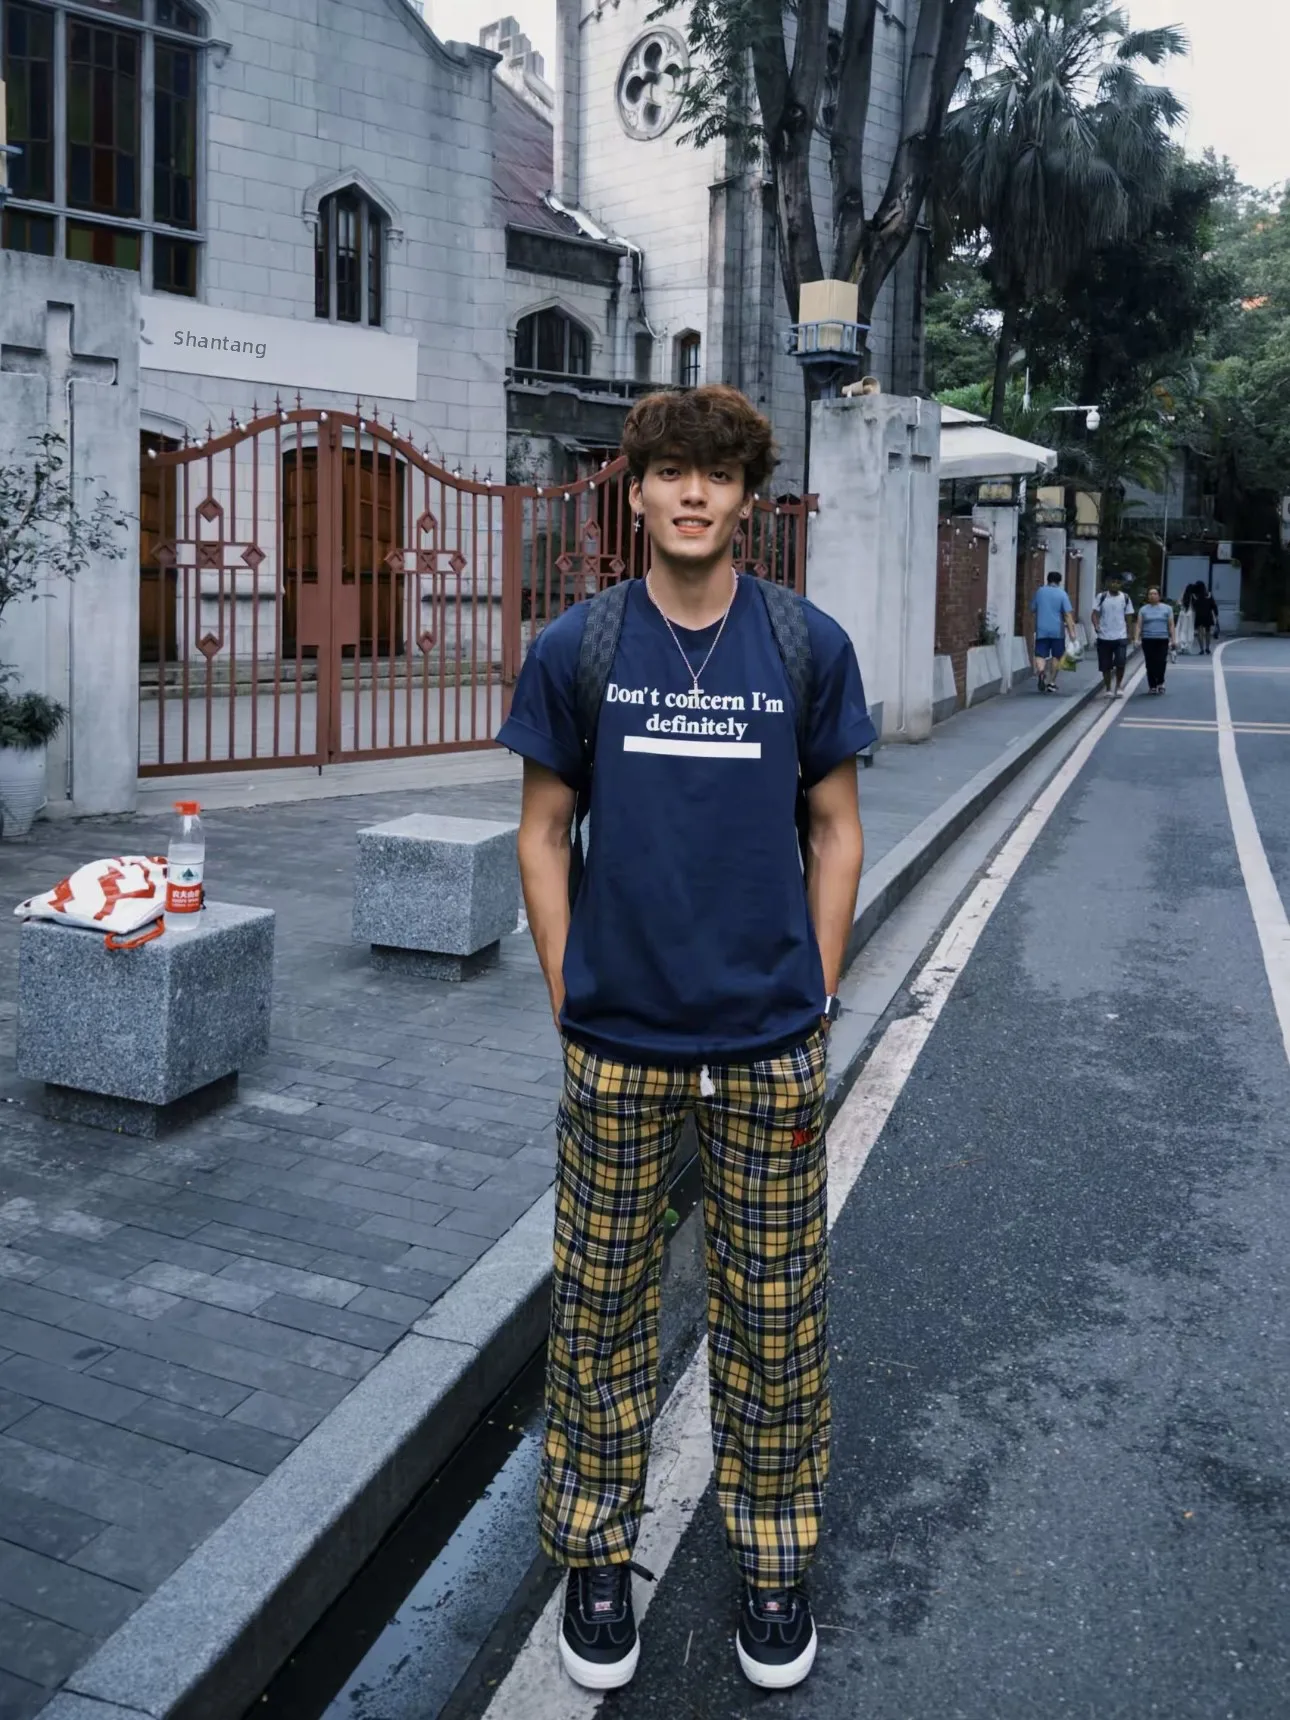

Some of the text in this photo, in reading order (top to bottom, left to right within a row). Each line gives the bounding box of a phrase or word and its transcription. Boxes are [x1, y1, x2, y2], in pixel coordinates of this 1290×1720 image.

[173, 330, 267, 359] Shantang
[606, 683, 785, 713] Don't concern I'm
[645, 713, 749, 741] definitely
